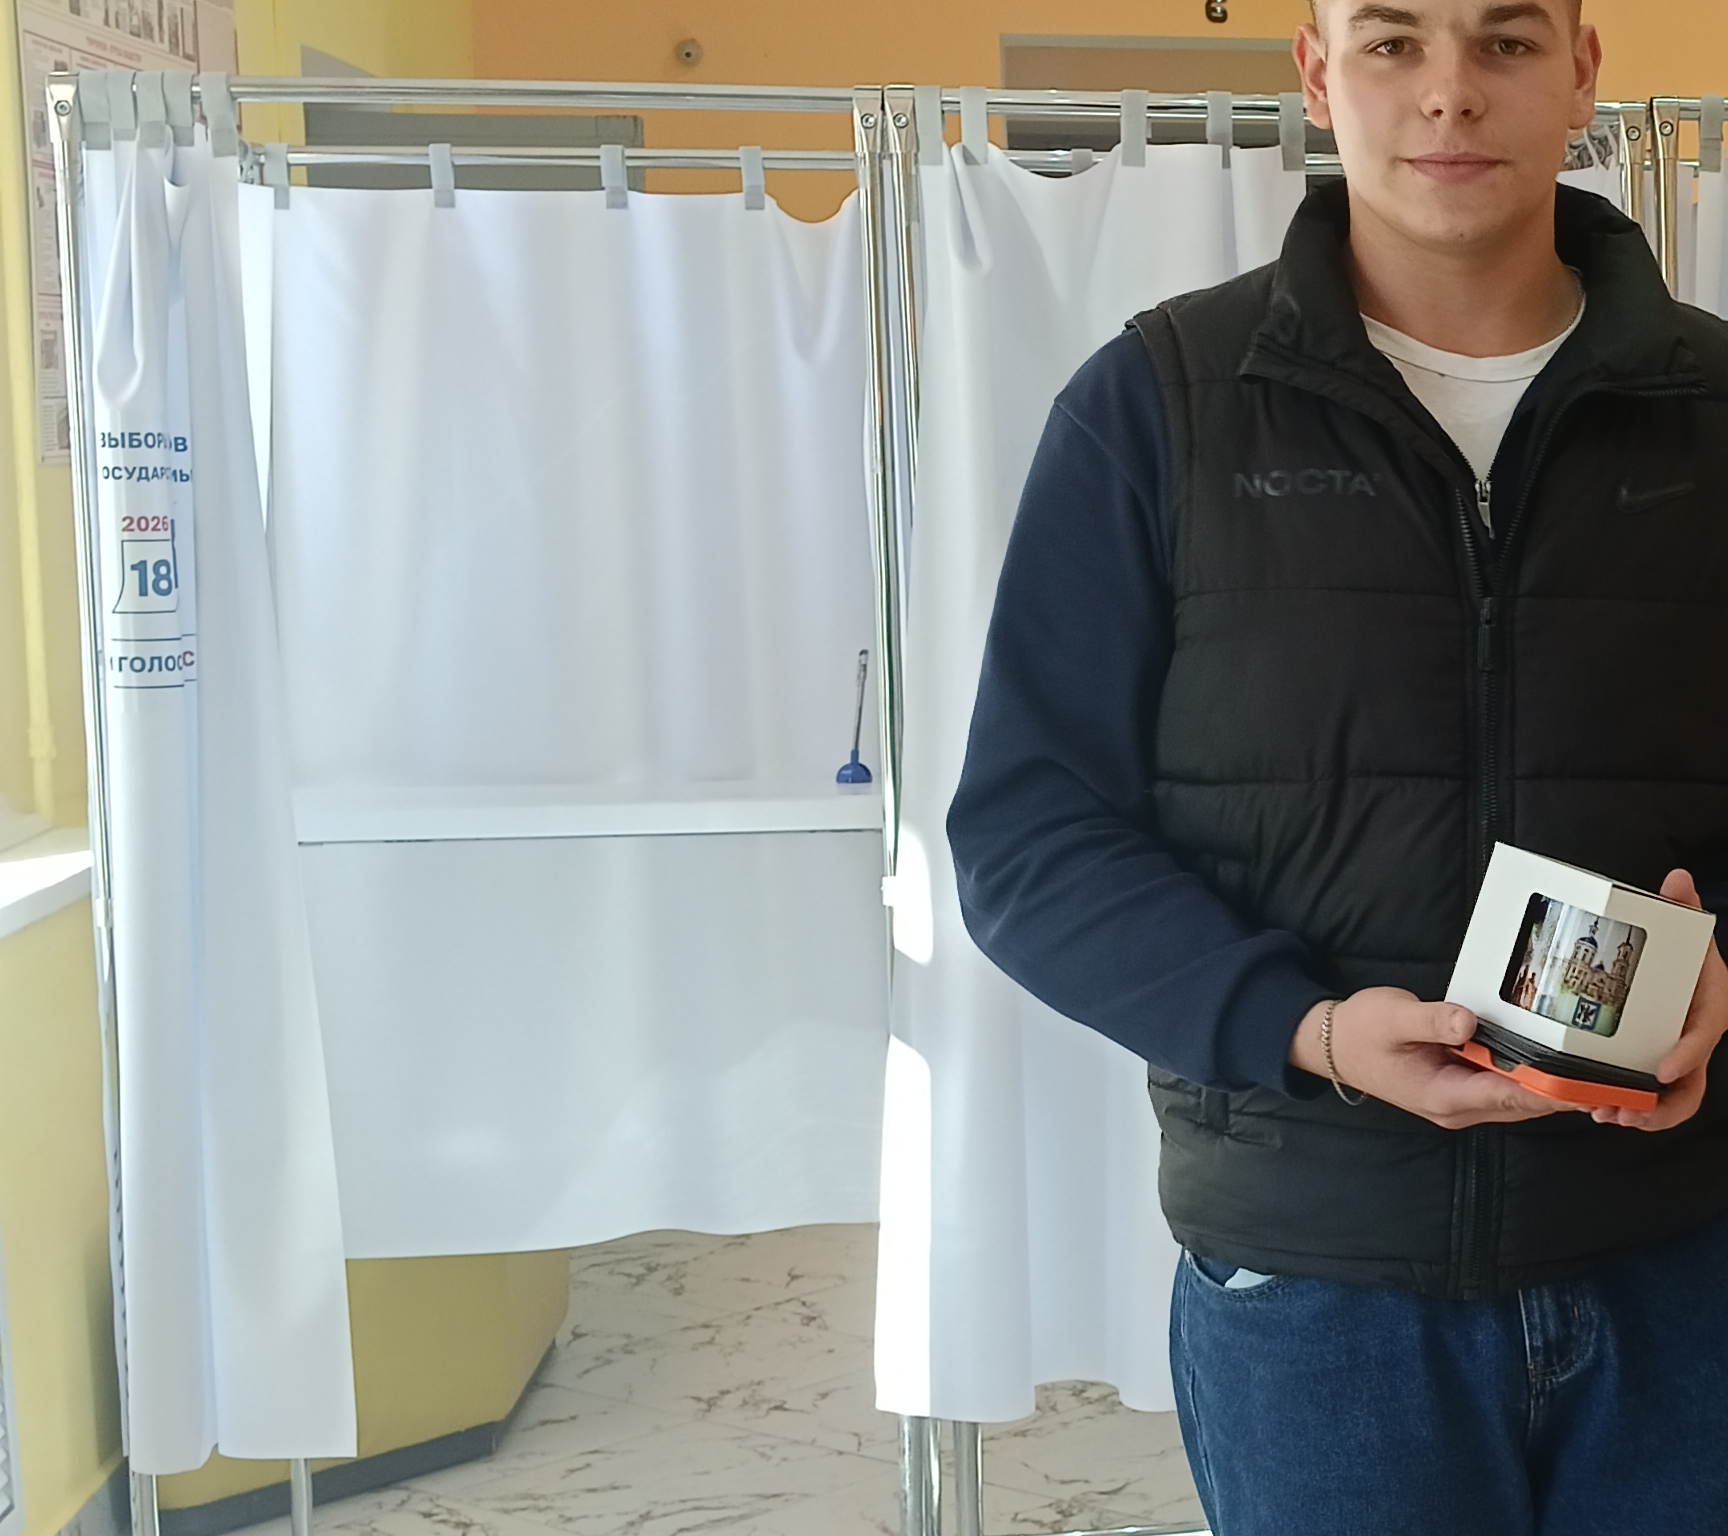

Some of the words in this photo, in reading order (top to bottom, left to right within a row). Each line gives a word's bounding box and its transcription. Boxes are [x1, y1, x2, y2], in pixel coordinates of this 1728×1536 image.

[1233, 469, 1377, 498] NOCTA
[122, 516, 168, 532] 2026
[130, 559, 172, 597] 18
